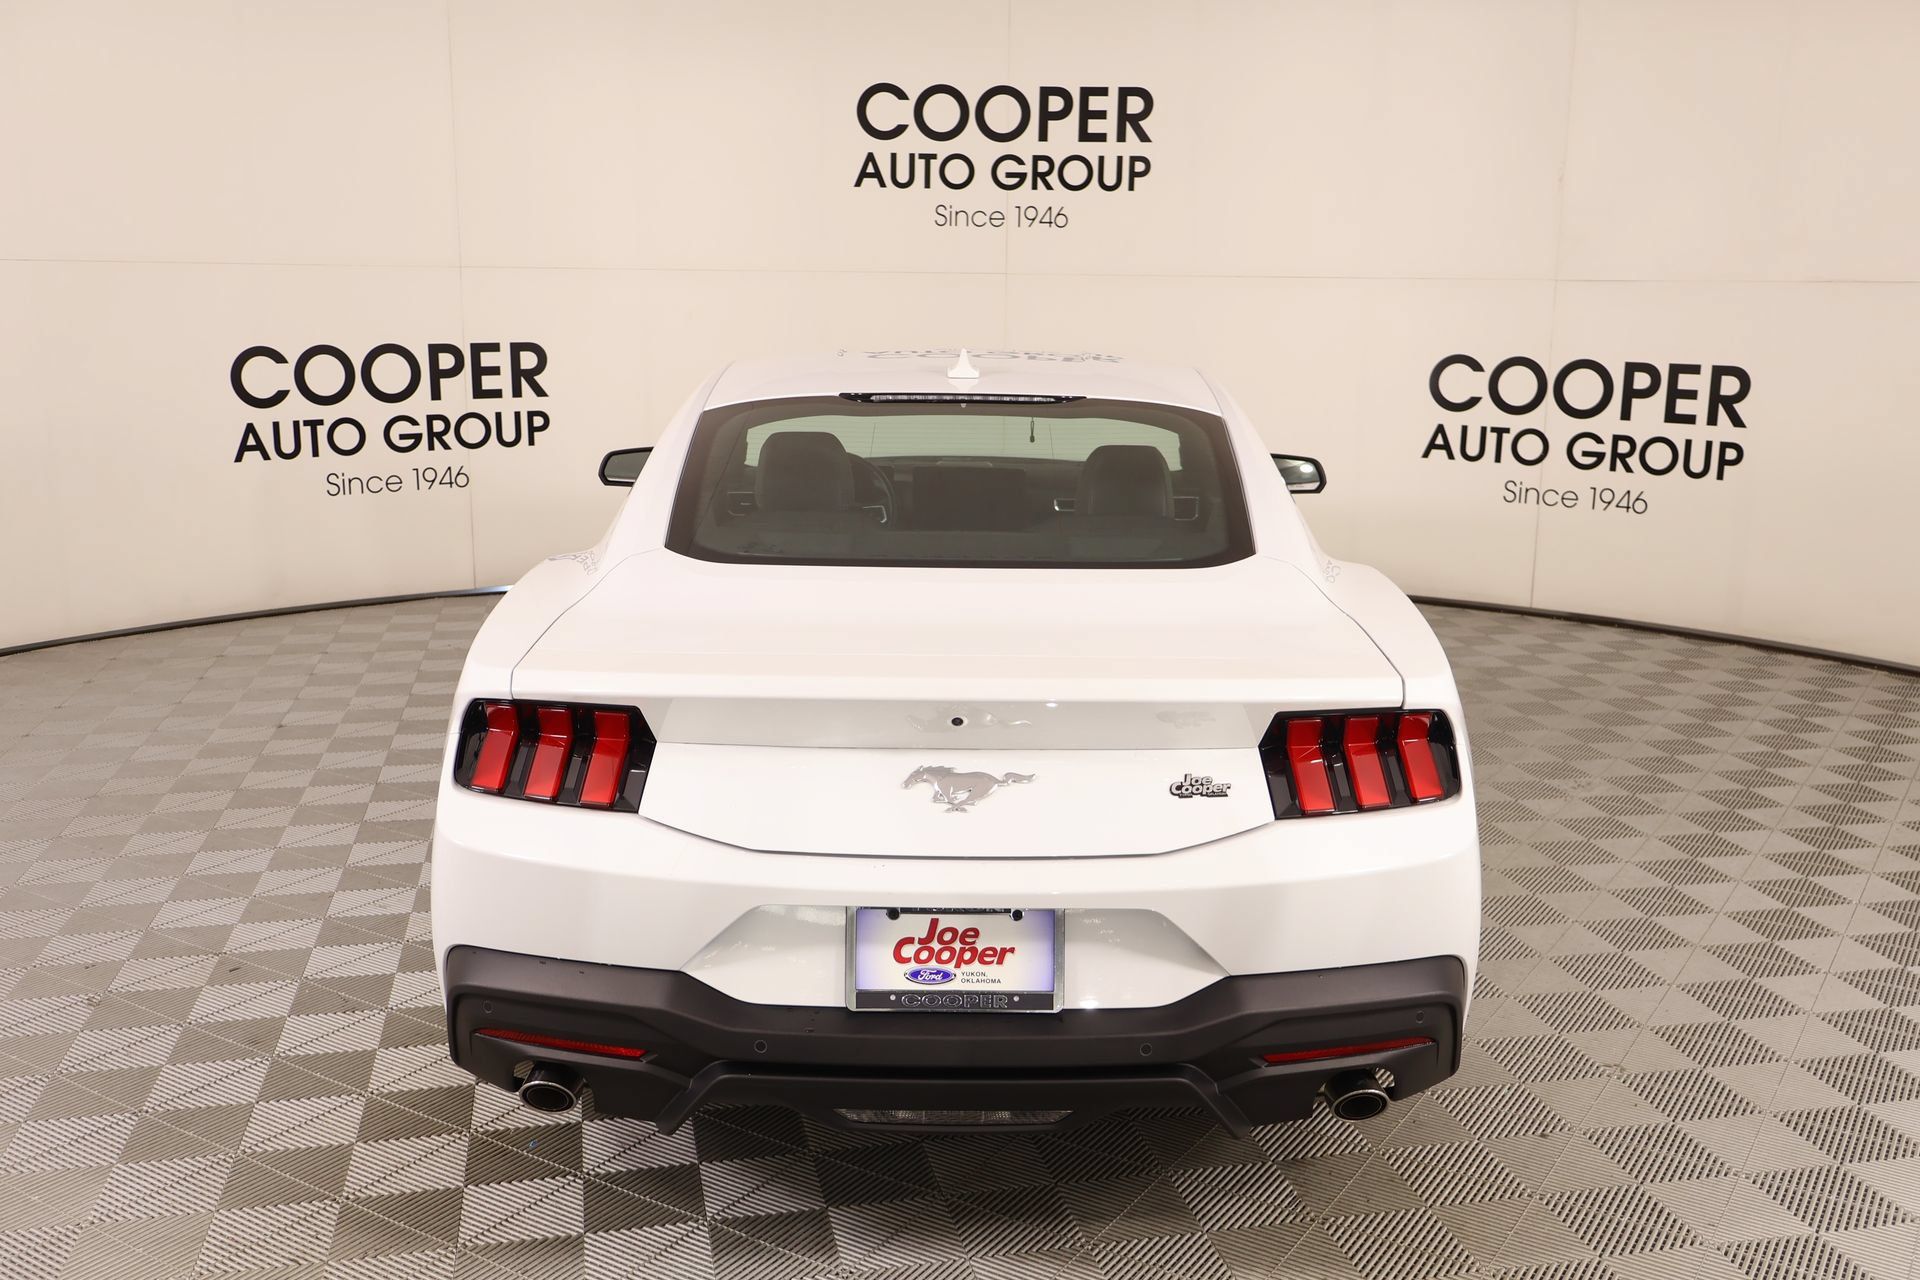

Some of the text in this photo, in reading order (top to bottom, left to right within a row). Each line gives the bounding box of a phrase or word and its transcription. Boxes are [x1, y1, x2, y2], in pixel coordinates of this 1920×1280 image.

[856, 82, 1154, 143] COOPER
[855, 152, 1152, 192] AUTO GROUP
[934, 204, 1069, 229] Since 1946
[230, 341, 549, 409] COOPER
[1430, 354, 1752, 429] COOPER
[234, 410, 550, 463] AUTO GROUP
[1422, 423, 1745, 482] AUTO GROUP
[326, 465, 470, 497] Since 1946
[1503, 479, 1648, 515] Since 1946
[1169, 781, 1232, 797] Cooper
[1184, 773, 1213, 785] Joe
[917, 917, 980, 946] Joe
[892, 936, 1016, 969] Cooper
[917, 969, 944, 981] Ford
[901, 993, 1009, 1009] COOPER
